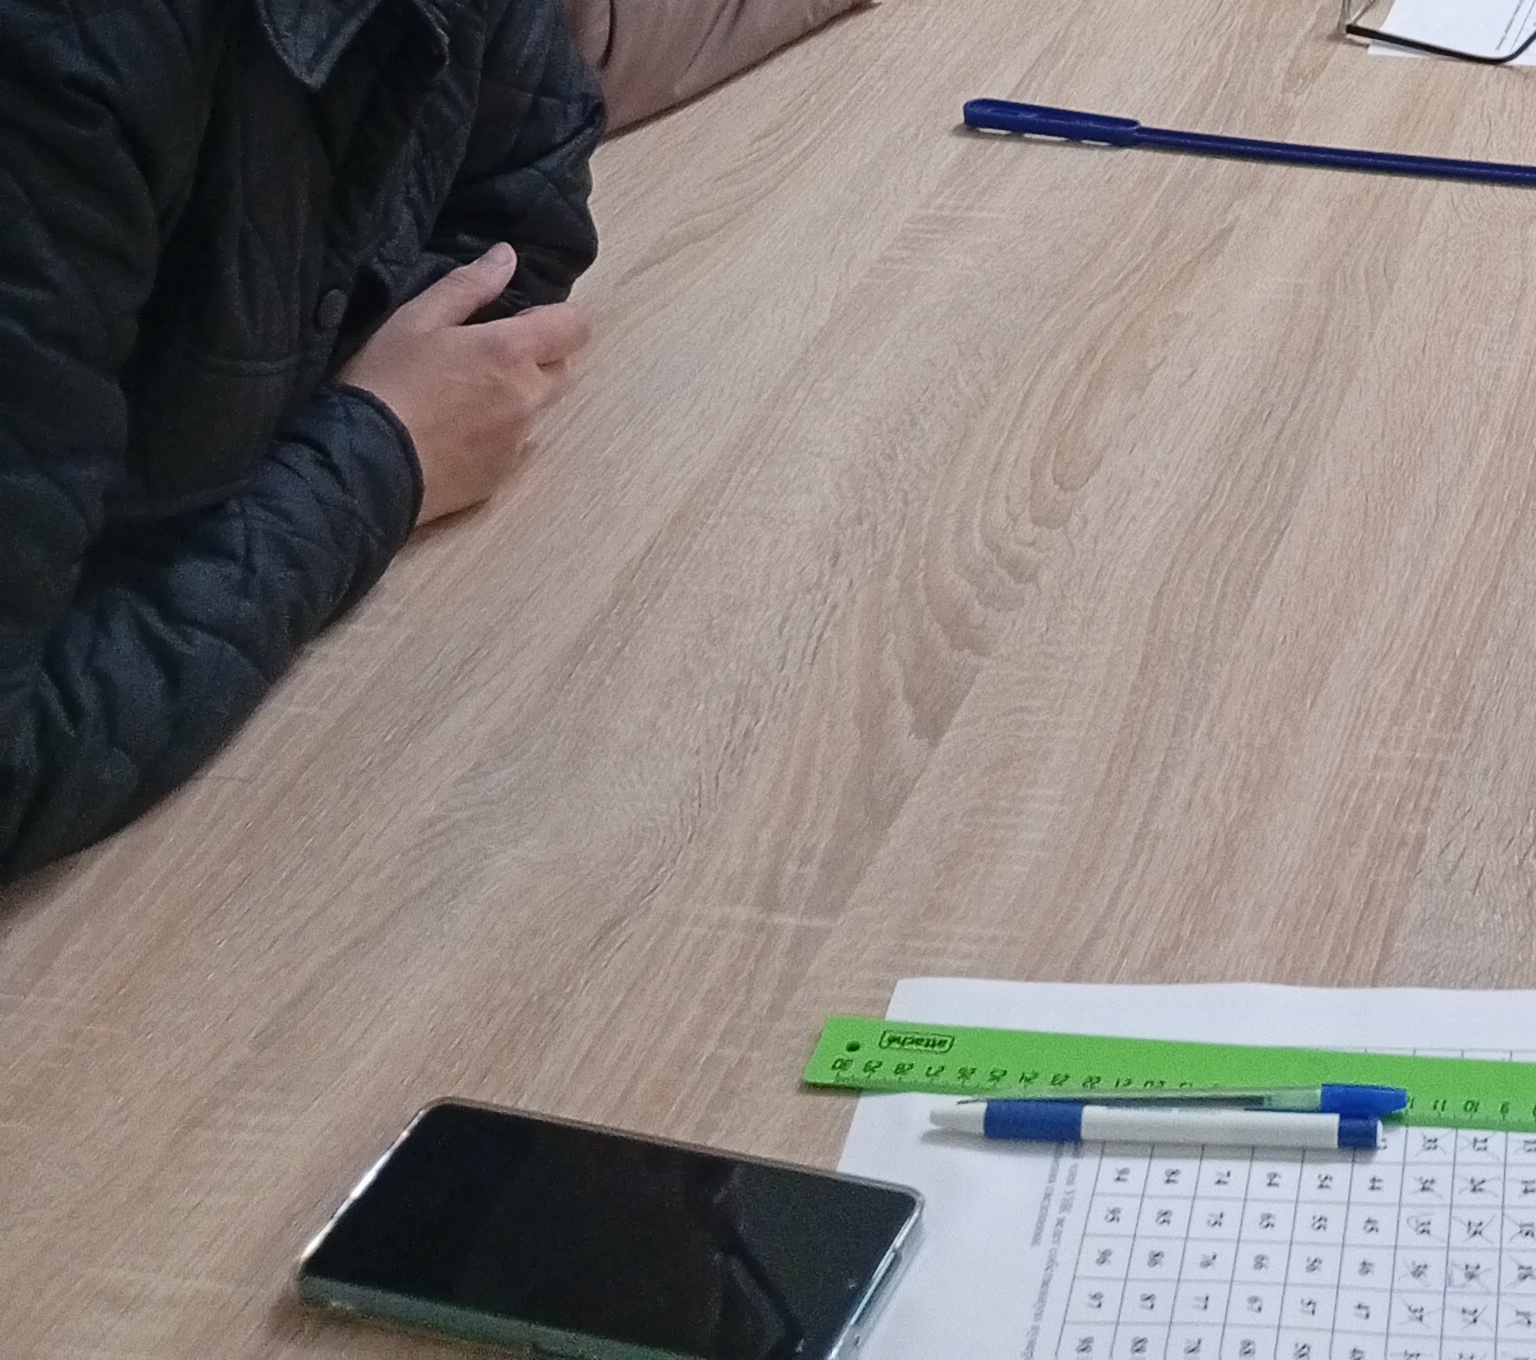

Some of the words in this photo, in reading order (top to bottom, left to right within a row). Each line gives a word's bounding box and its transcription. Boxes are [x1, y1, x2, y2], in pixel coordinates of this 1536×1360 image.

[1113, 1167, 1130, 1182] 94
[1164, 1168, 1181, 1184] 84
[1214, 1170, 1231, 1186] 74
[1266, 1172, 1282, 1188] 64
[1317, 1173, 1333, 1190] 54
[1368, 1176, 1384, 1191] 44
[1104, 1206, 1122, 1224] 95
[1156, 1209, 1173, 1226] 85
[1207, 1211, 1224, 1228] 75
[1259, 1212, 1276, 1229] 65
[1311, 1215, 1328, 1231] 55
[1364, 1217, 1380, 1233] 45
[1253, 1254, 1270, 1271] 66
[1305, 1256, 1322, 1274] 56
[1358, 1260, 1375, 1276] 46
[1087, 1291, 1104, 1309] 97
[1139, 1293, 1157, 1310] 87
[1193, 1294, 1210, 1311] 77
[1246, 1295, 1264, 1314] 67
[1300, 1298, 1317, 1316] 57
[1354, 1302, 1371, 1320] 47
[1130, 1336, 1149, 1355] 88
